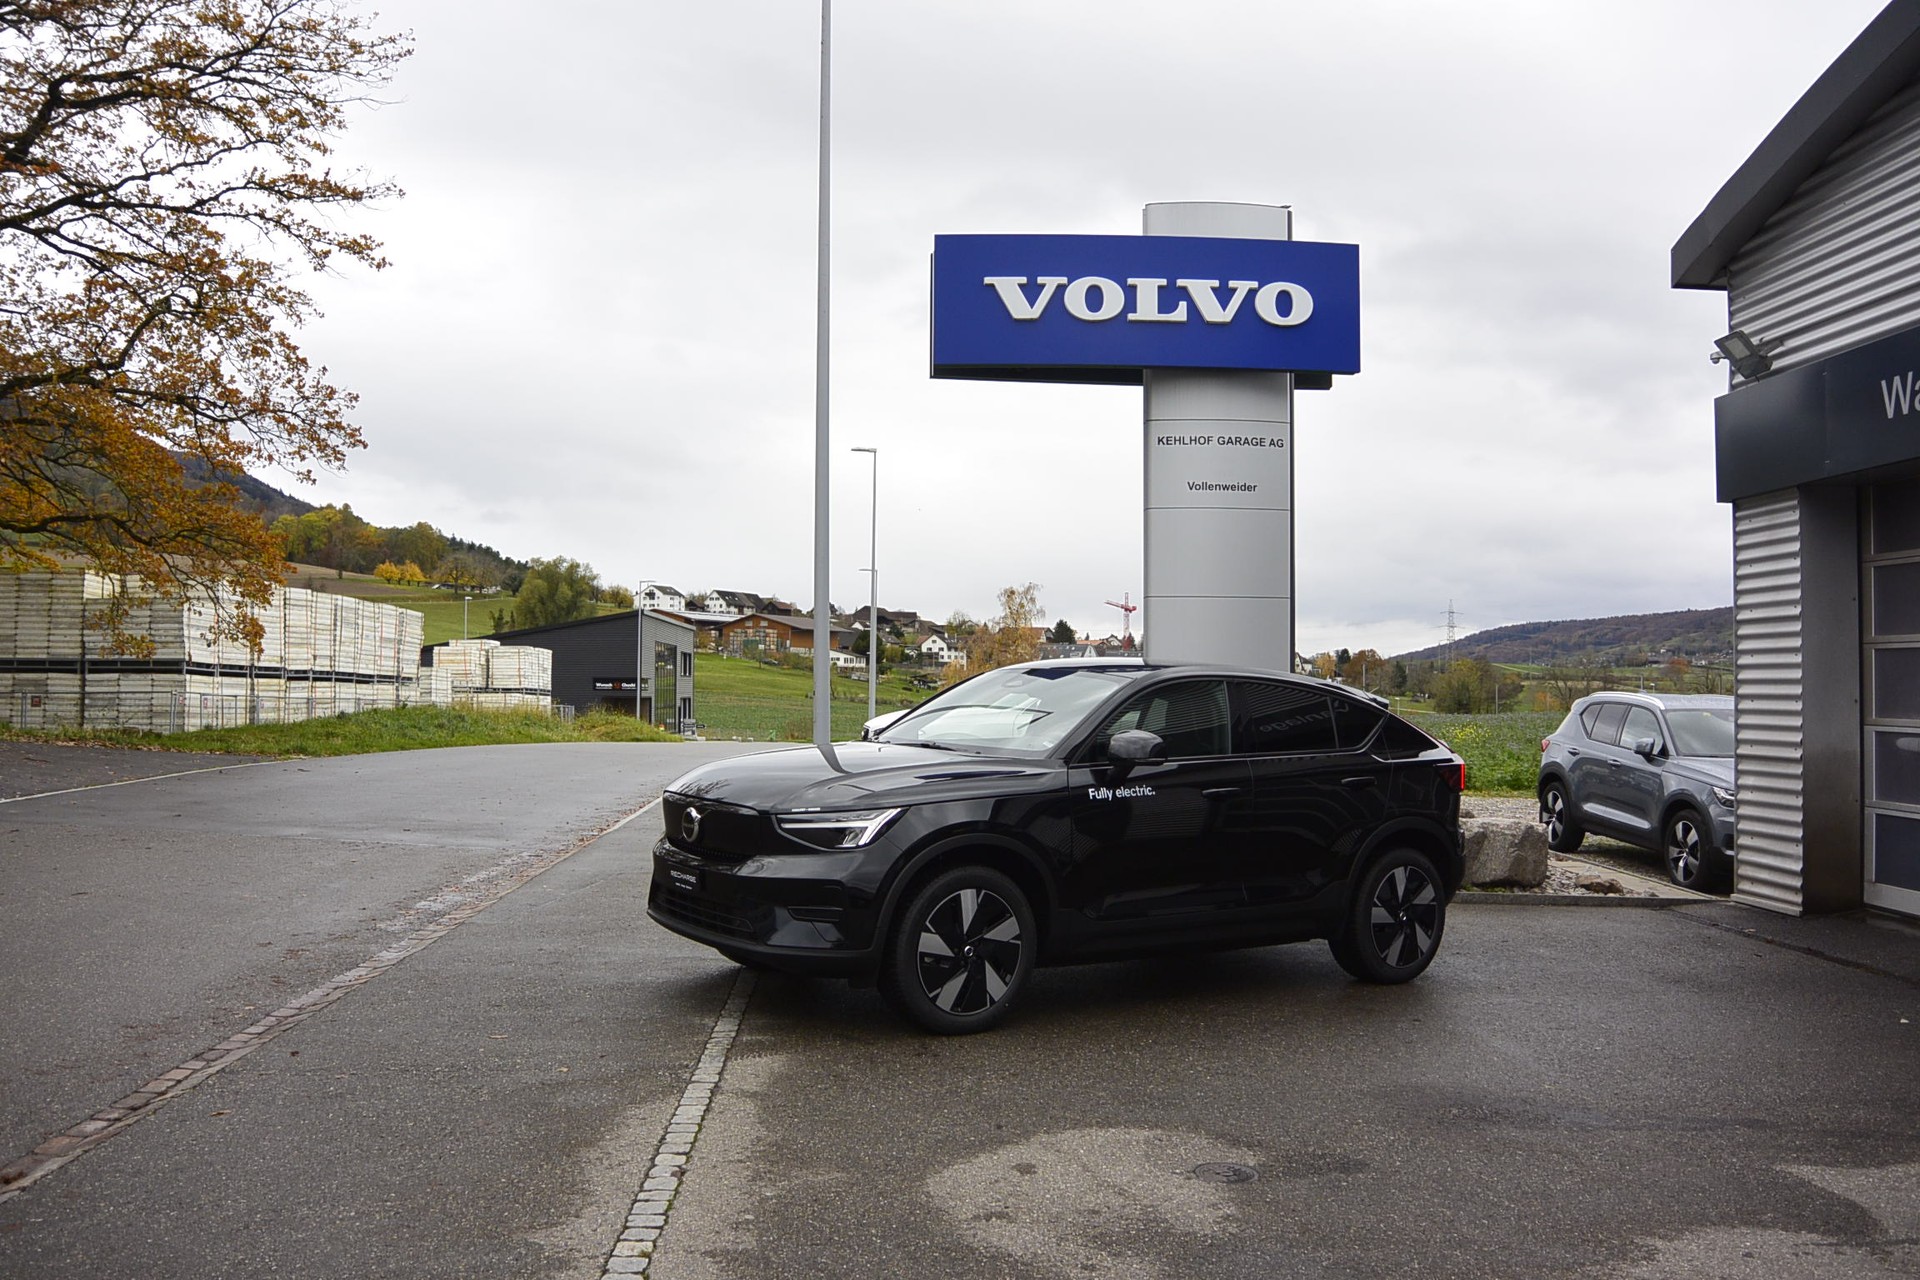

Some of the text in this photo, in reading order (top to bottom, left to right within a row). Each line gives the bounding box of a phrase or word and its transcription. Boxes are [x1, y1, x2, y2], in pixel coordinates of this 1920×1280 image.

[983, 276, 1314, 326] VOLVO
[1157, 436, 1284, 449] KEHLHOF GARAGE AG
[1187, 481, 1258, 493] Vollenweider
[1088, 784, 1156, 801] Fully electric.
